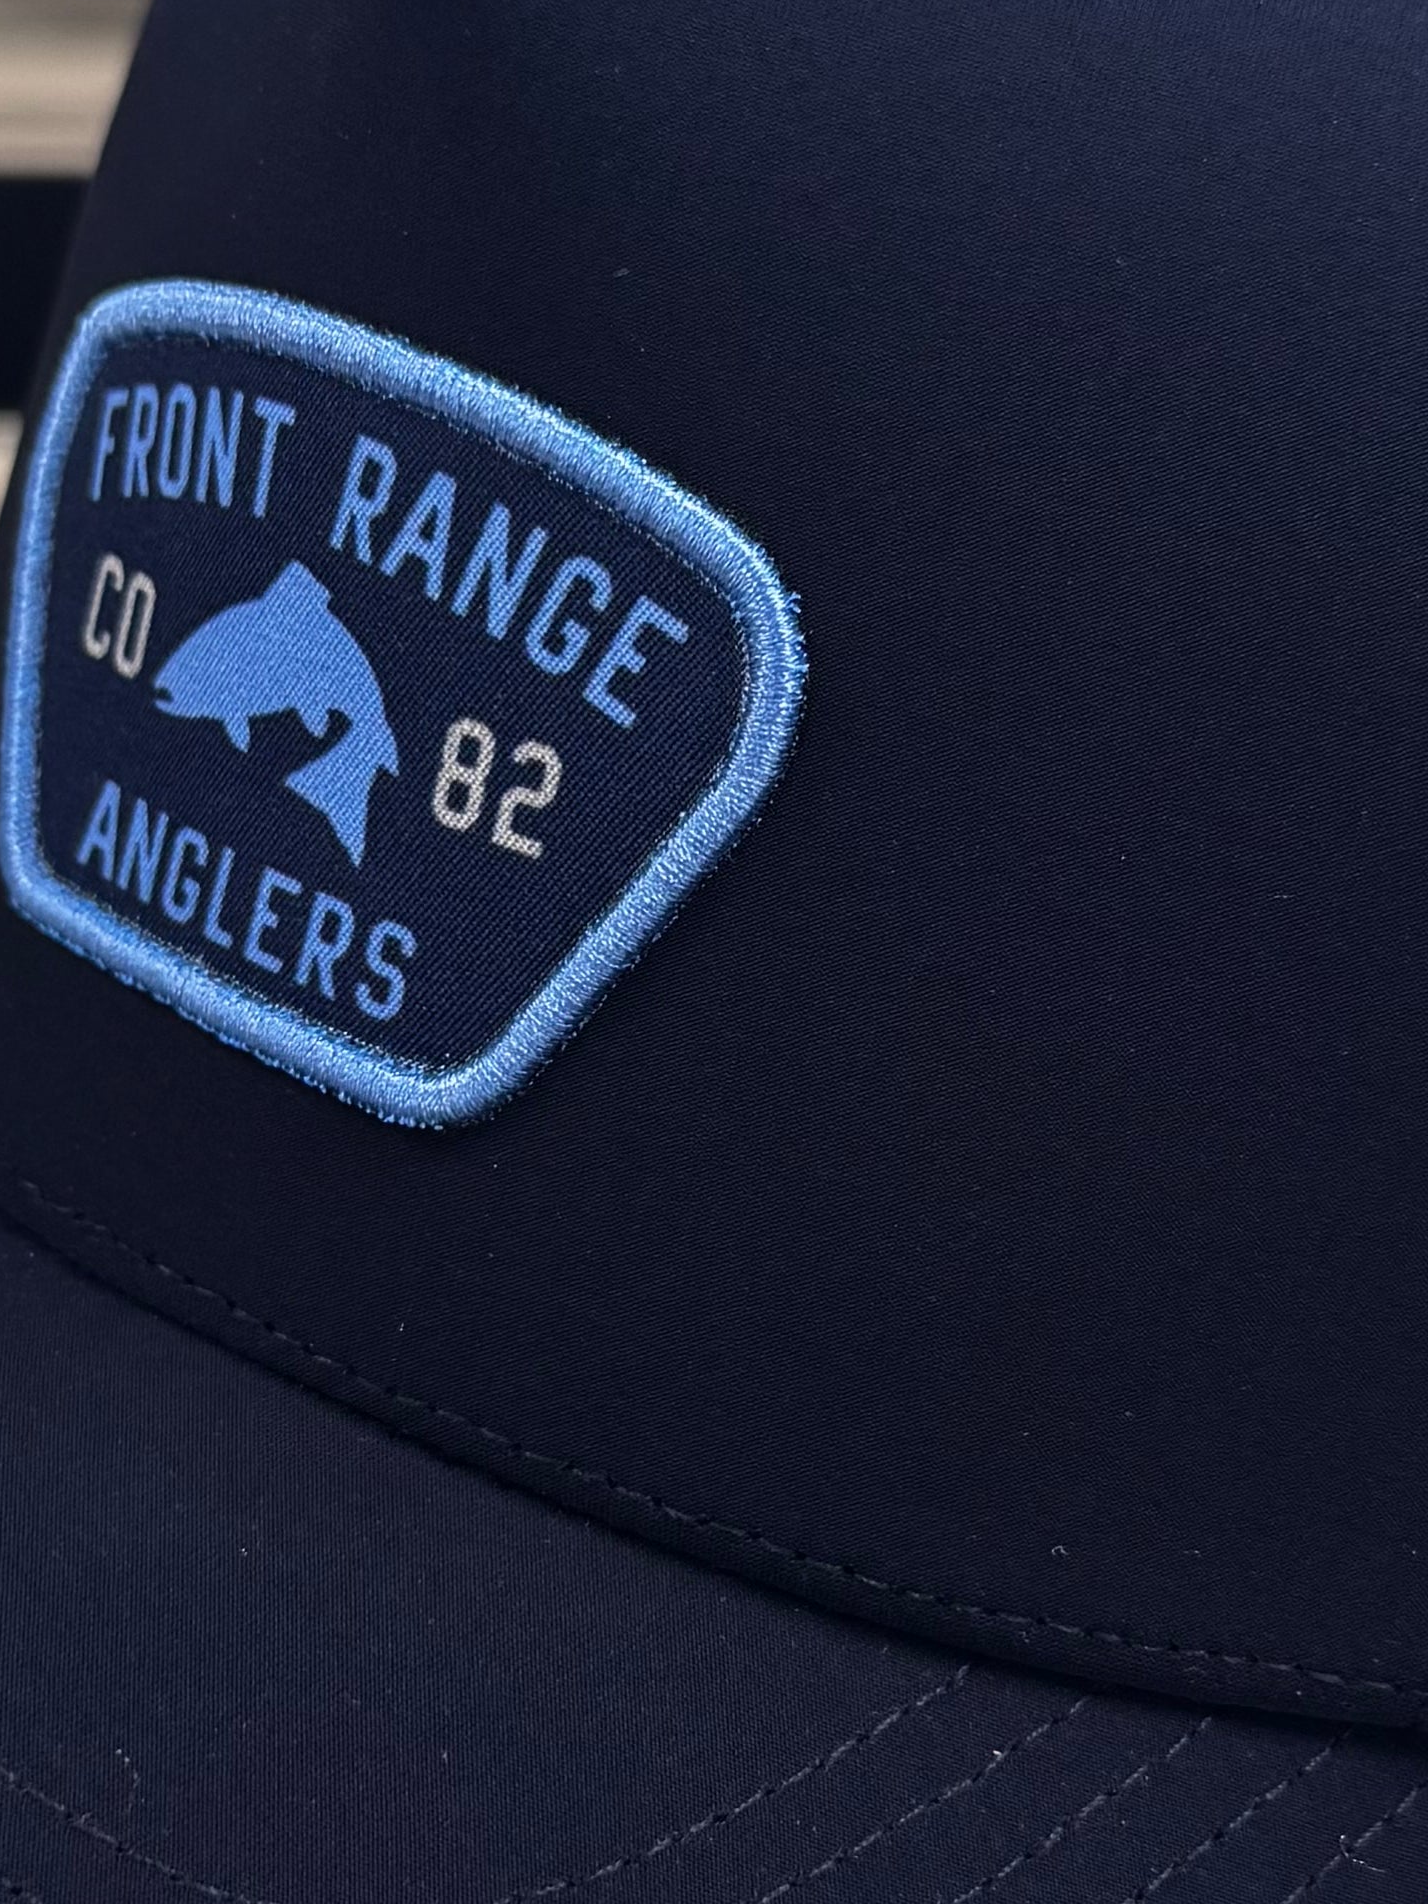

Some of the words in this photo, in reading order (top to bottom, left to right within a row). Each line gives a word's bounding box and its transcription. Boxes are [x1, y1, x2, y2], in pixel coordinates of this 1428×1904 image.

[83, 555, 154, 678] CO
[91, 386, 295, 517] FRONT
[332, 436, 689, 728] RANGE
[433, 719, 562, 859] 82
[77, 781, 418, 1020] ANGLERS
